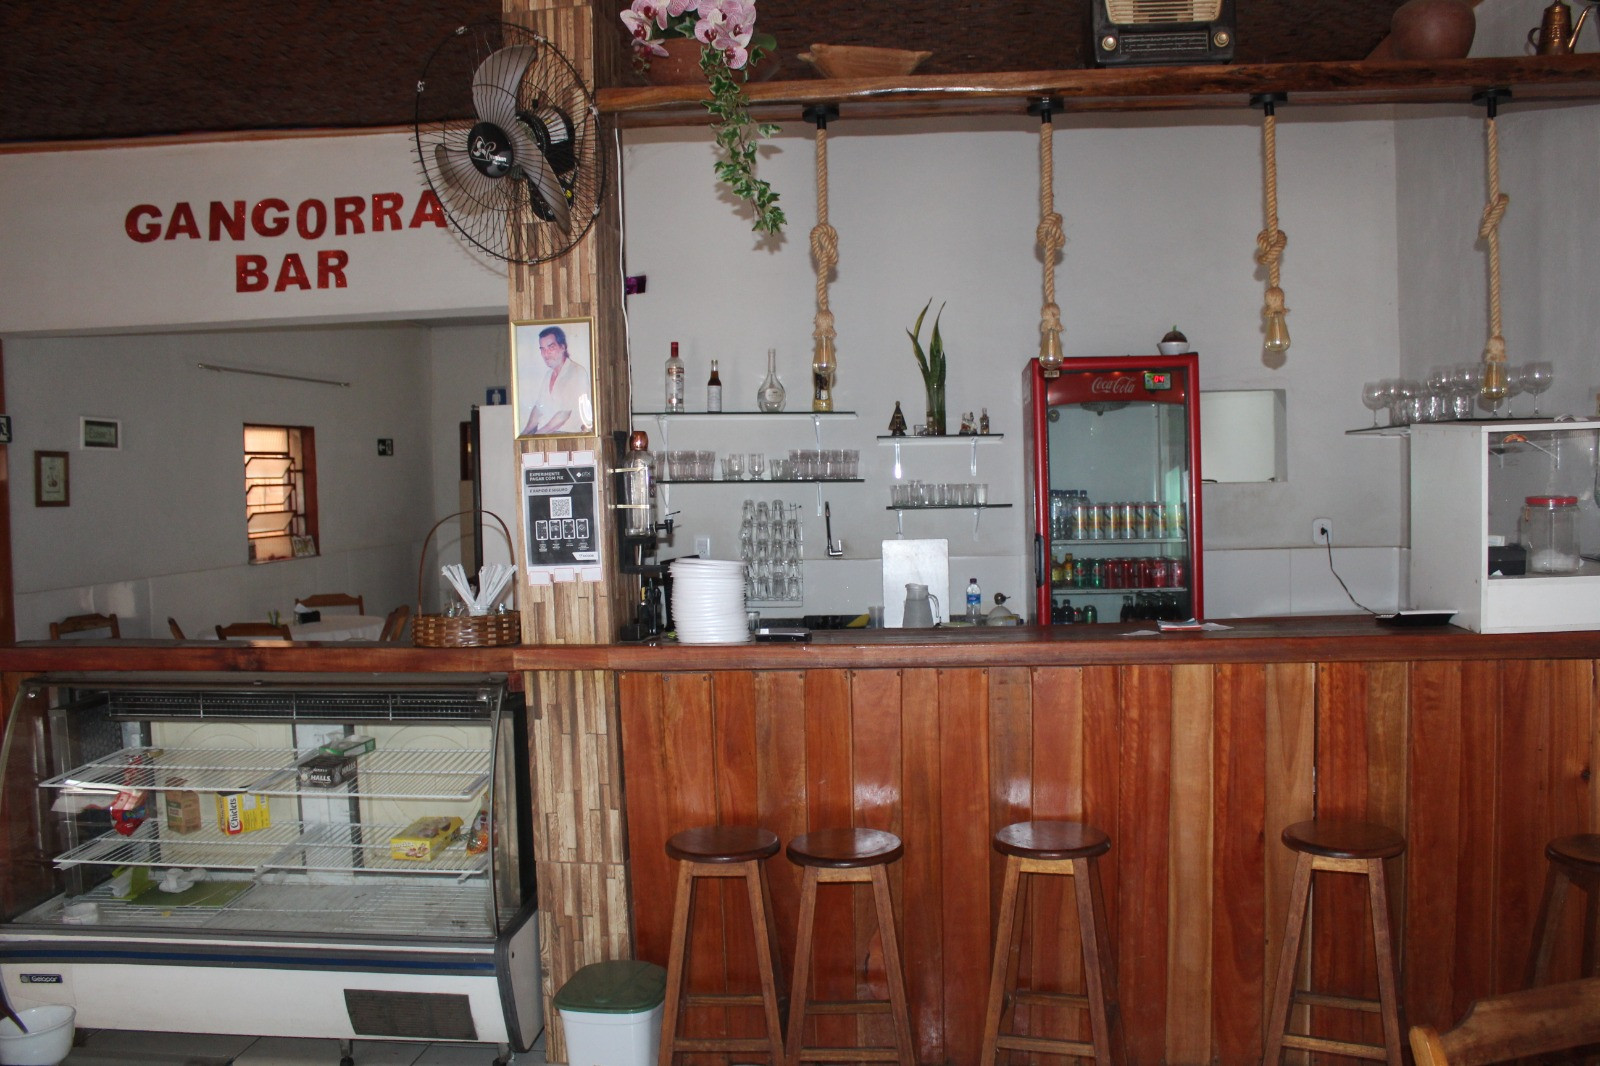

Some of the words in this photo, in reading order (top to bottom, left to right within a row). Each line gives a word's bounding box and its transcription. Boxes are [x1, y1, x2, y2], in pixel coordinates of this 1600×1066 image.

[124, 189, 448, 243] GANGORRA
[236, 250, 349, 293] BAR
[310, 774, 331, 782] HALLS
